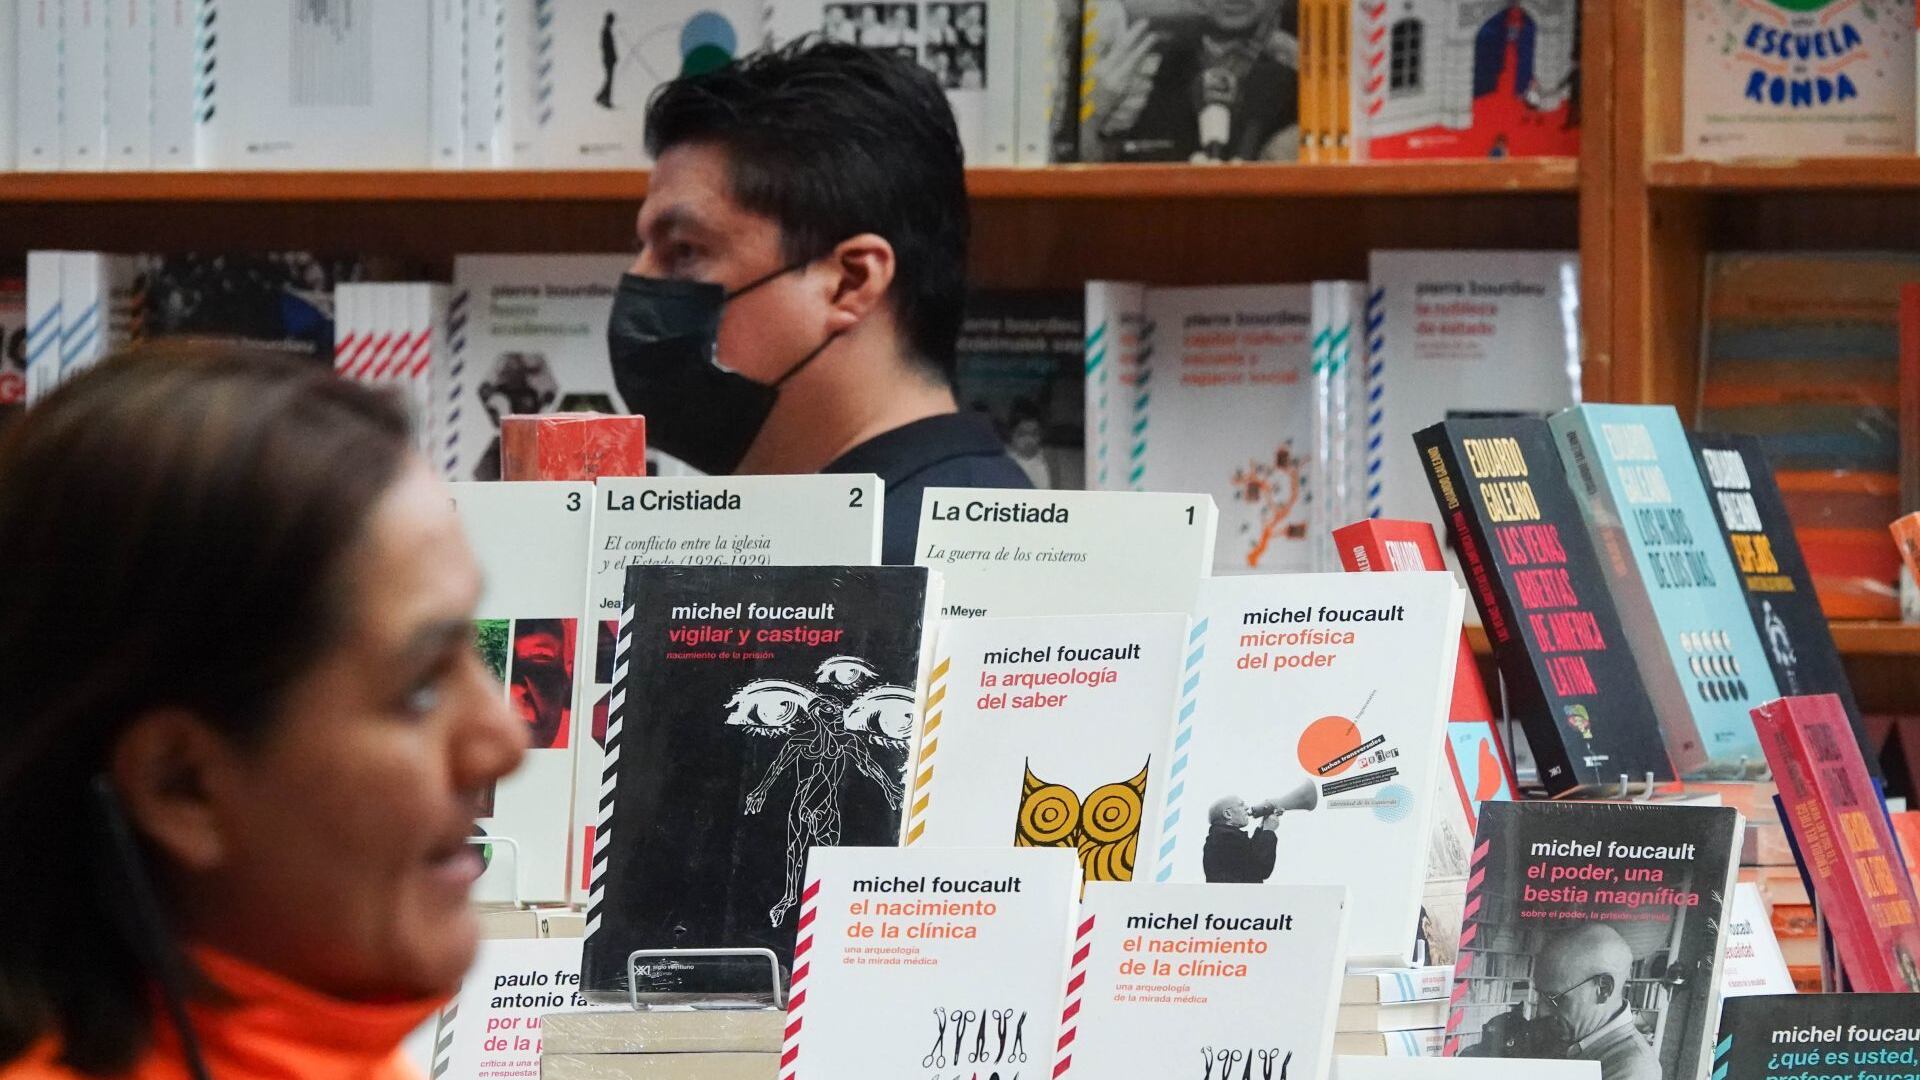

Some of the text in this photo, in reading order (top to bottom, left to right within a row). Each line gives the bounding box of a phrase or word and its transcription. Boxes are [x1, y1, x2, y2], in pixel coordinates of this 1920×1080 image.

[1744, 22, 1862, 60] ESCUELA
[1744, 70, 1858, 108] RONDA
[1427, 446, 1448, 479] GALEANO
[1463, 437, 1528, 478] EDUARDO
[566, 492, 581, 511] 3
[607, 487, 863, 511] La Cristiada 2
[1480, 481, 1541, 522] GALEANO
[931, 501, 1195, 525] La Cristiada 1
[604, 534, 772, 554] El conflicto entre la iglesia
[926, 544, 1087, 563] La guerra de los cristeros
[1495, 526, 1528, 565] LAS
[1519, 524, 1568, 564] VENAS
[1730, 533, 1779, 574] ESPEJOS
[598, 559, 611, 574] y
[614, 558, 626, 570] el
[599, 598, 622, 609] Jea
[671, 602, 835, 620] michel foucault
[950, 606, 987, 618] Meyer
[1243, 605, 1405, 625] michel foucault
[669, 625, 844, 647] vigilar y castigar
[1240, 628, 1356, 648] microfísica
[1529, 614, 1556, 653] DE
[666, 652, 774, 662] nacimiento de la prisión
[983, 643, 1142, 664] michel foucault
[1236, 650, 1337, 672] del poder
[980, 666, 1118, 690] la arqueología
[1545, 656, 1598, 696] LATINA
[976, 691, 1068, 710] del saber
[1321, 738, 1382, 773] luchas transversales
[1531, 840, 1696, 860] michel foucault
[1527, 862, 1664, 884] el poder, una
[852, 876, 1022, 893] michel foucault
[1523, 884, 1700, 909] bestia magnífica
[849, 899, 997, 916] el nacimiento
[1520, 909, 1547, 919] sobre
[1549, 909, 1558, 919] el
[1559, 910, 1589, 921] poder,
[1590, 911, 1599, 920] la
[847, 921, 977, 939] de la clínica
[1126, 913, 1293, 931] michel foucault
[1730, 920, 1754, 936] oucault
[844, 945, 920, 956] una arqueología
[1123, 935, 1268, 954] el nacimiento
[842, 955, 938, 966] de la mirada médica
[1119, 958, 1248, 977] de la clínica
[494, 970, 580, 991] paulo fre
[1115, 983, 1191, 994] una arqueología
[490, 992, 564, 1008] antonio
[1114, 993, 1208, 1004] de la mirada médica
[486, 1016, 521, 1033] por
[483, 1036, 508, 1051] de
[513, 1035, 531, 1051] la
[1771, 1025, 1920, 1044] michel foucau
[1767, 1047, 1919, 1070] ¿qué es usted,
[491, 1069, 538, 1079] respuestas
